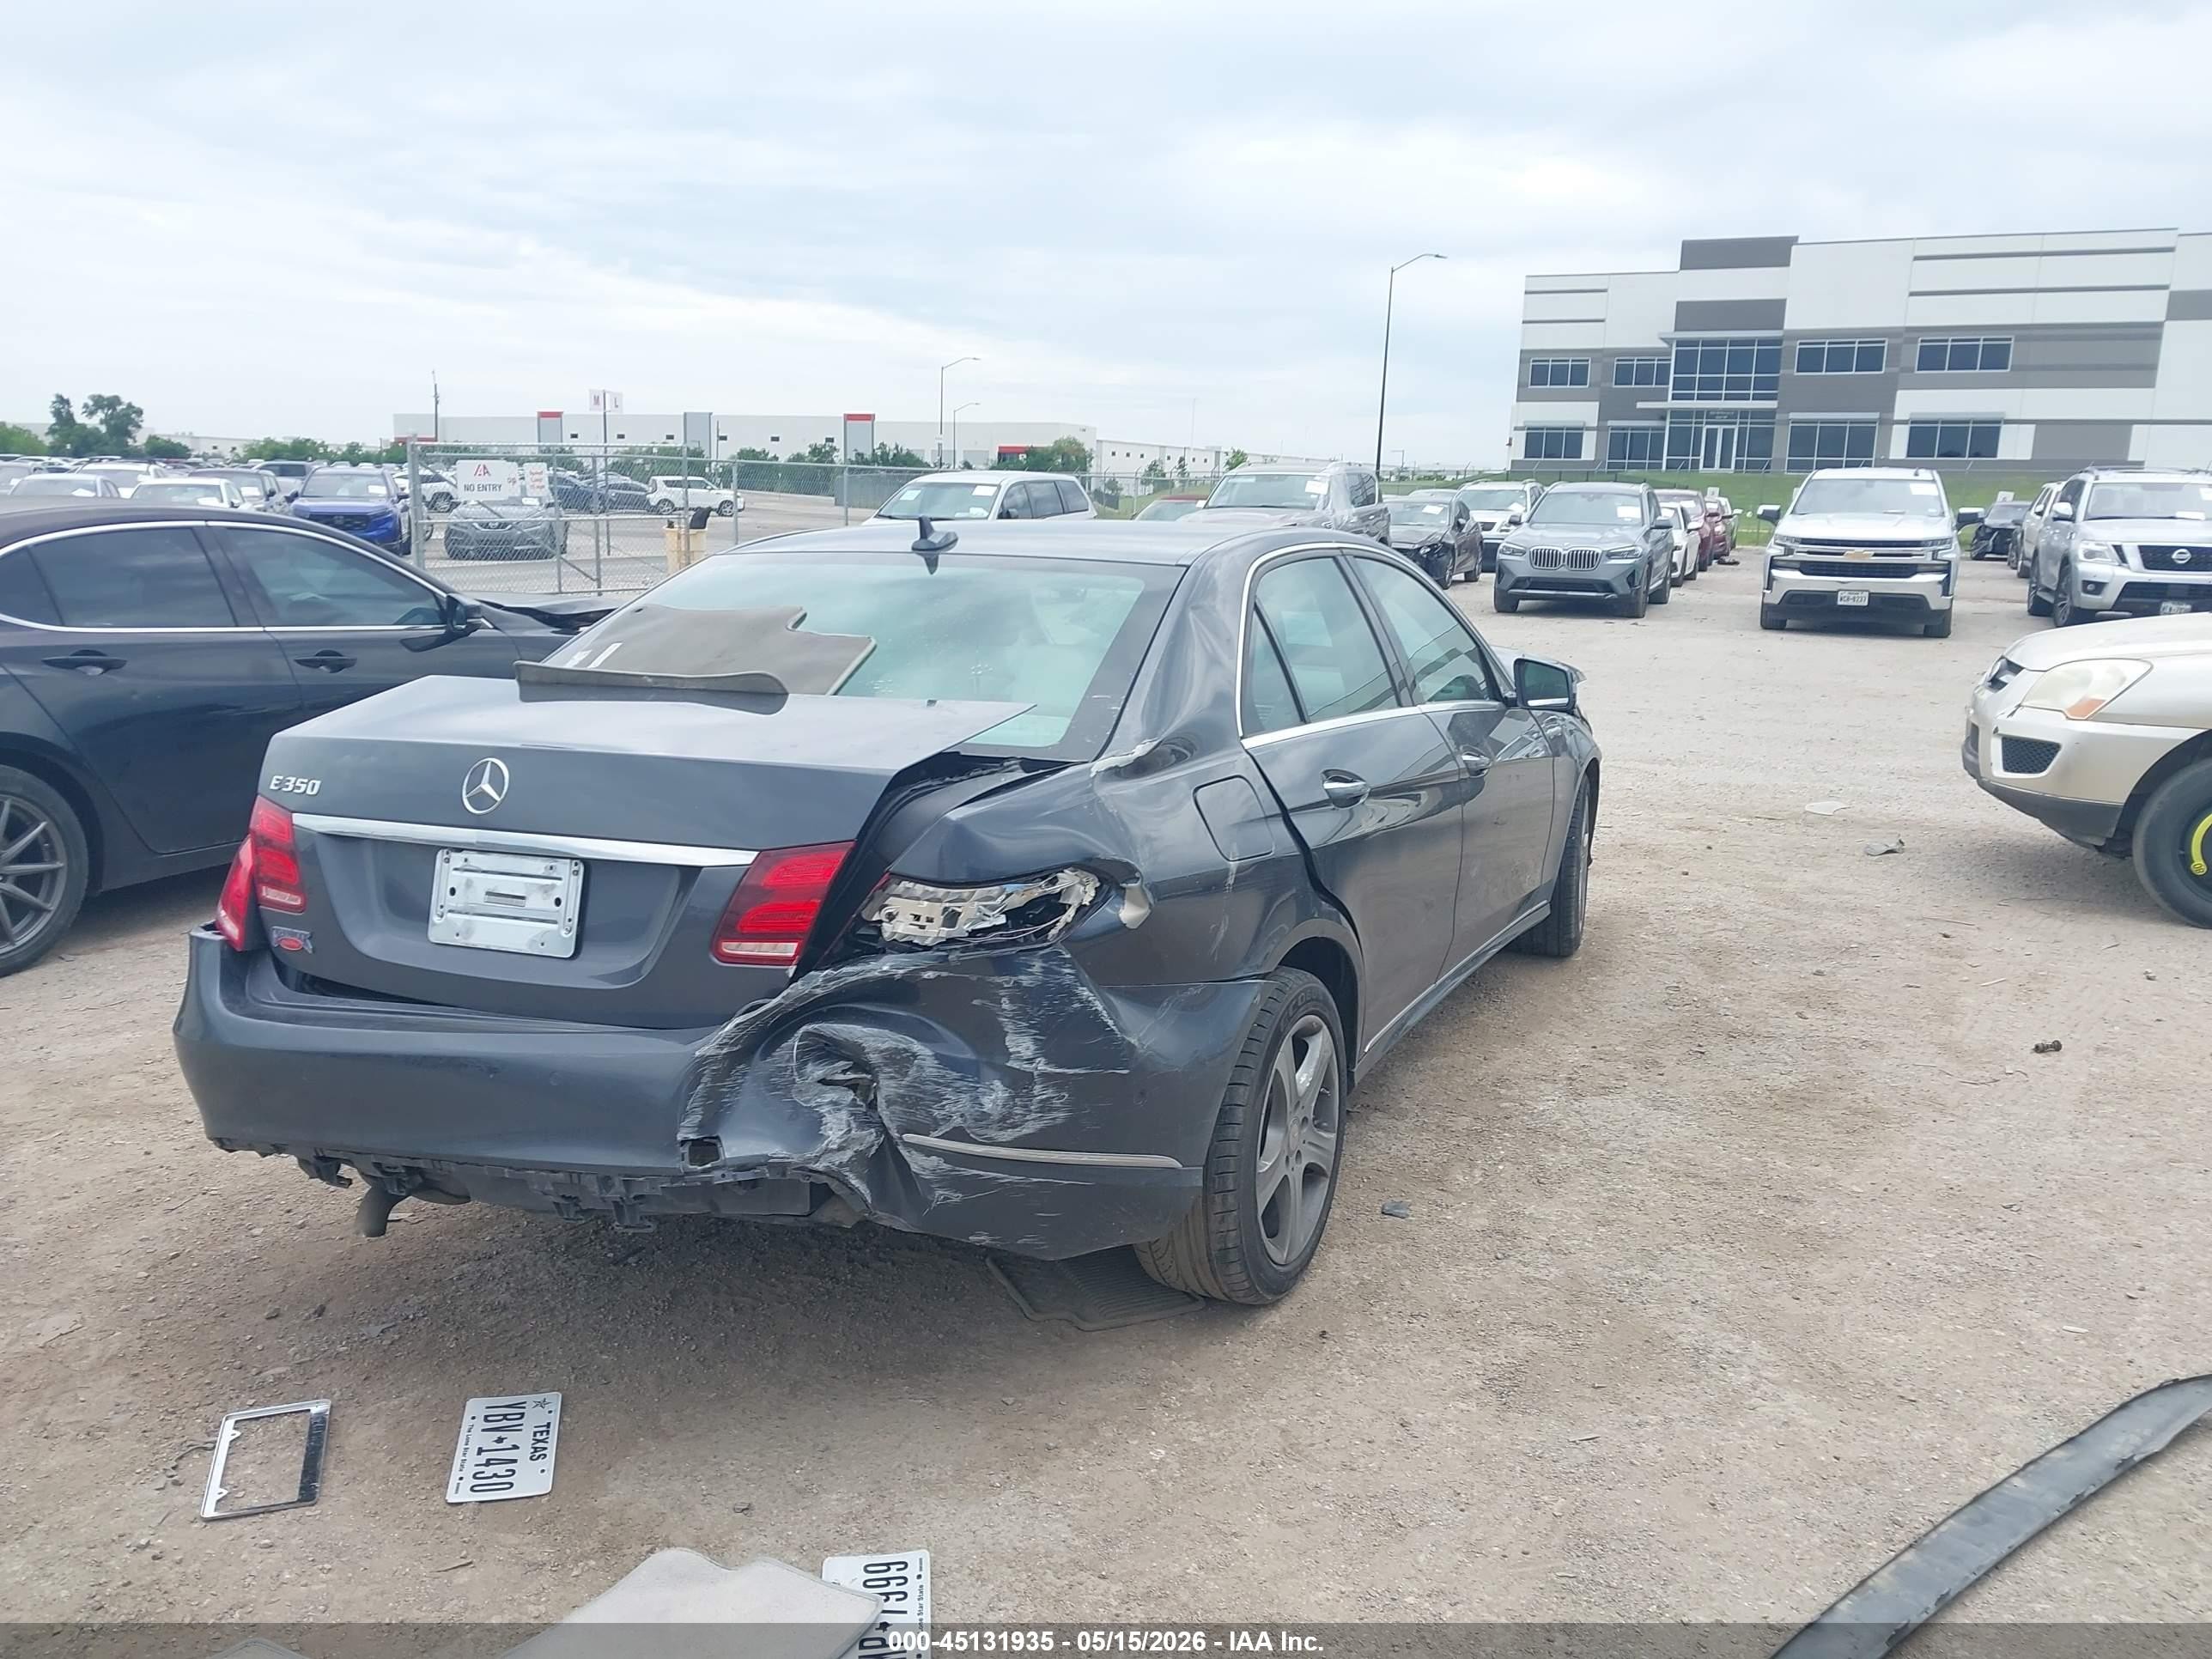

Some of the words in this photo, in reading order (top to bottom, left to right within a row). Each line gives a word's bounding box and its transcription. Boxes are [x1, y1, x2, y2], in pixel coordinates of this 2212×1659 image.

[464, 483, 475, 492] NO
[477, 483, 502, 492] ENTRY
[529, 1422, 551, 1462] TEXAS
[459, 1458, 467, 1472] State
